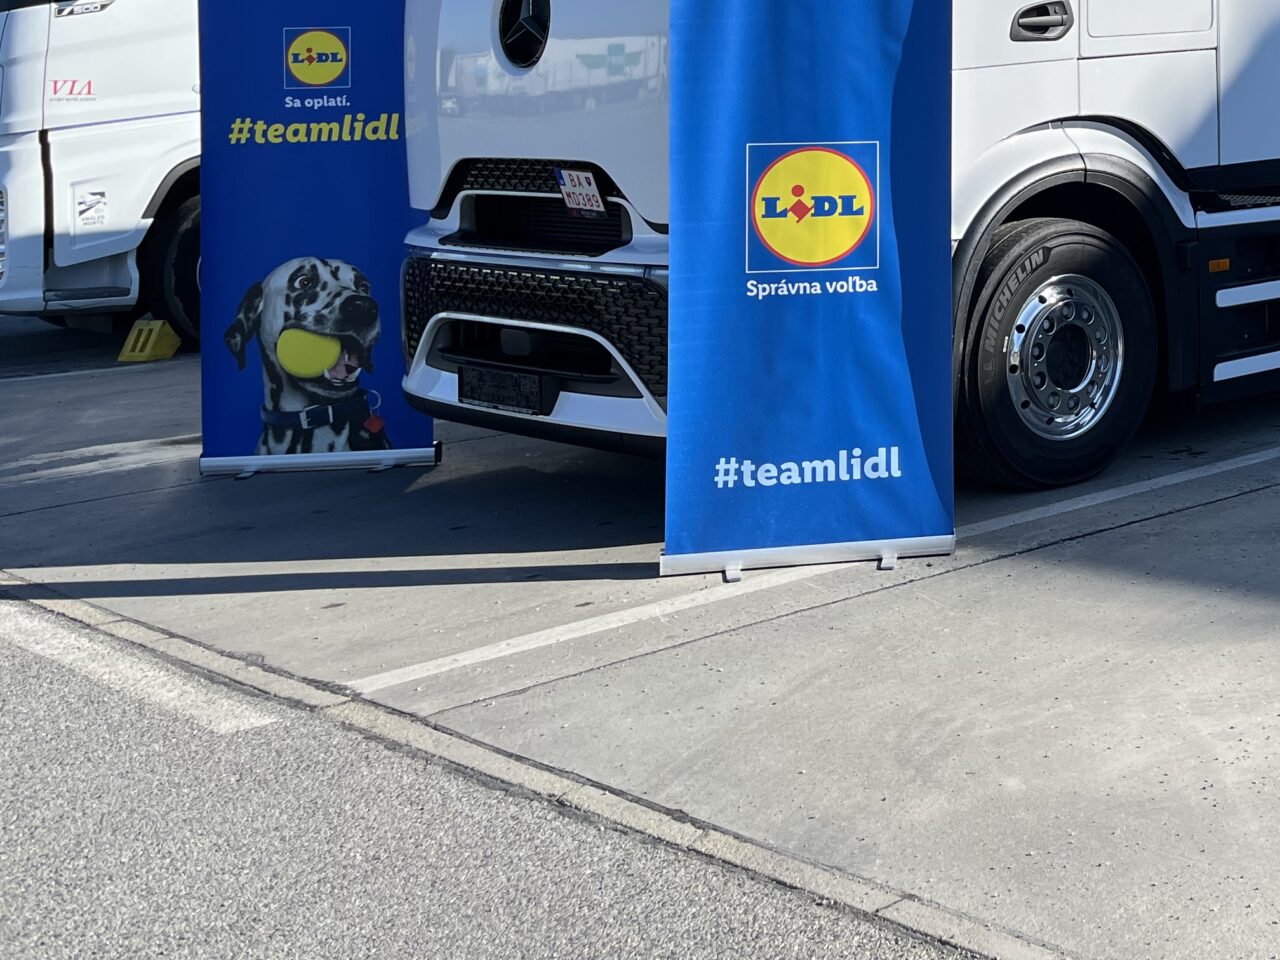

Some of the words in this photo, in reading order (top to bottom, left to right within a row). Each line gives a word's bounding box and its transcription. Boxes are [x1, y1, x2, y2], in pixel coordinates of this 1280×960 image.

[50, 79, 95, 96] VIA
[285, 96, 301, 108] Sa
[304, 95, 350, 109] oplatí.
[229, 113, 399, 144] #teamlidl
[568, 173, 584, 188] BA
[566, 191, 600, 208] MD389
[746, 279, 821, 300] Správna
[826, 276, 878, 293] voľba
[984, 246, 1046, 356] MICHELIN
[714, 446, 902, 488] #teamlidl
